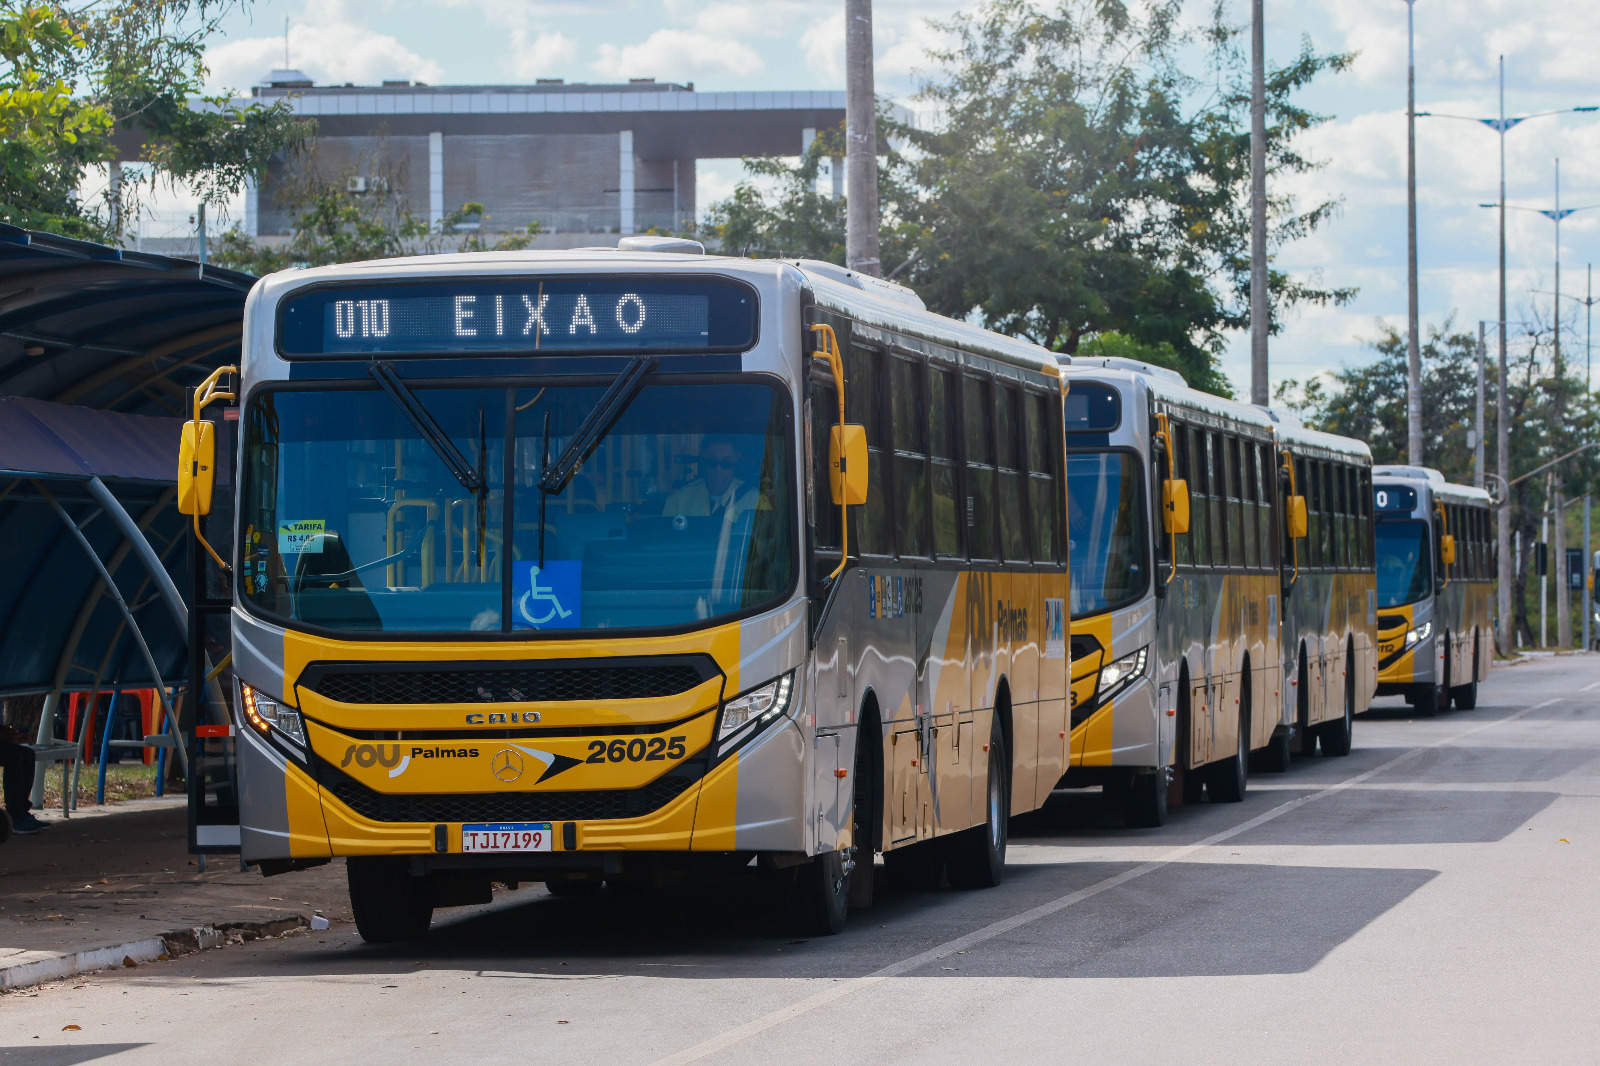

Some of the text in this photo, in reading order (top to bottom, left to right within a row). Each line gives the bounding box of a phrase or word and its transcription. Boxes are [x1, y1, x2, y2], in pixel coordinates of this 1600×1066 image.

[335, 293, 646, 337] 010 EIXAO
[997, 600, 1027, 643] Palmas
[466, 712, 542, 725] CAIO
[411, 747, 480, 759] Palmas
[587, 736, 686, 764] 26025
[470, 832, 542, 849] TJI7I99
